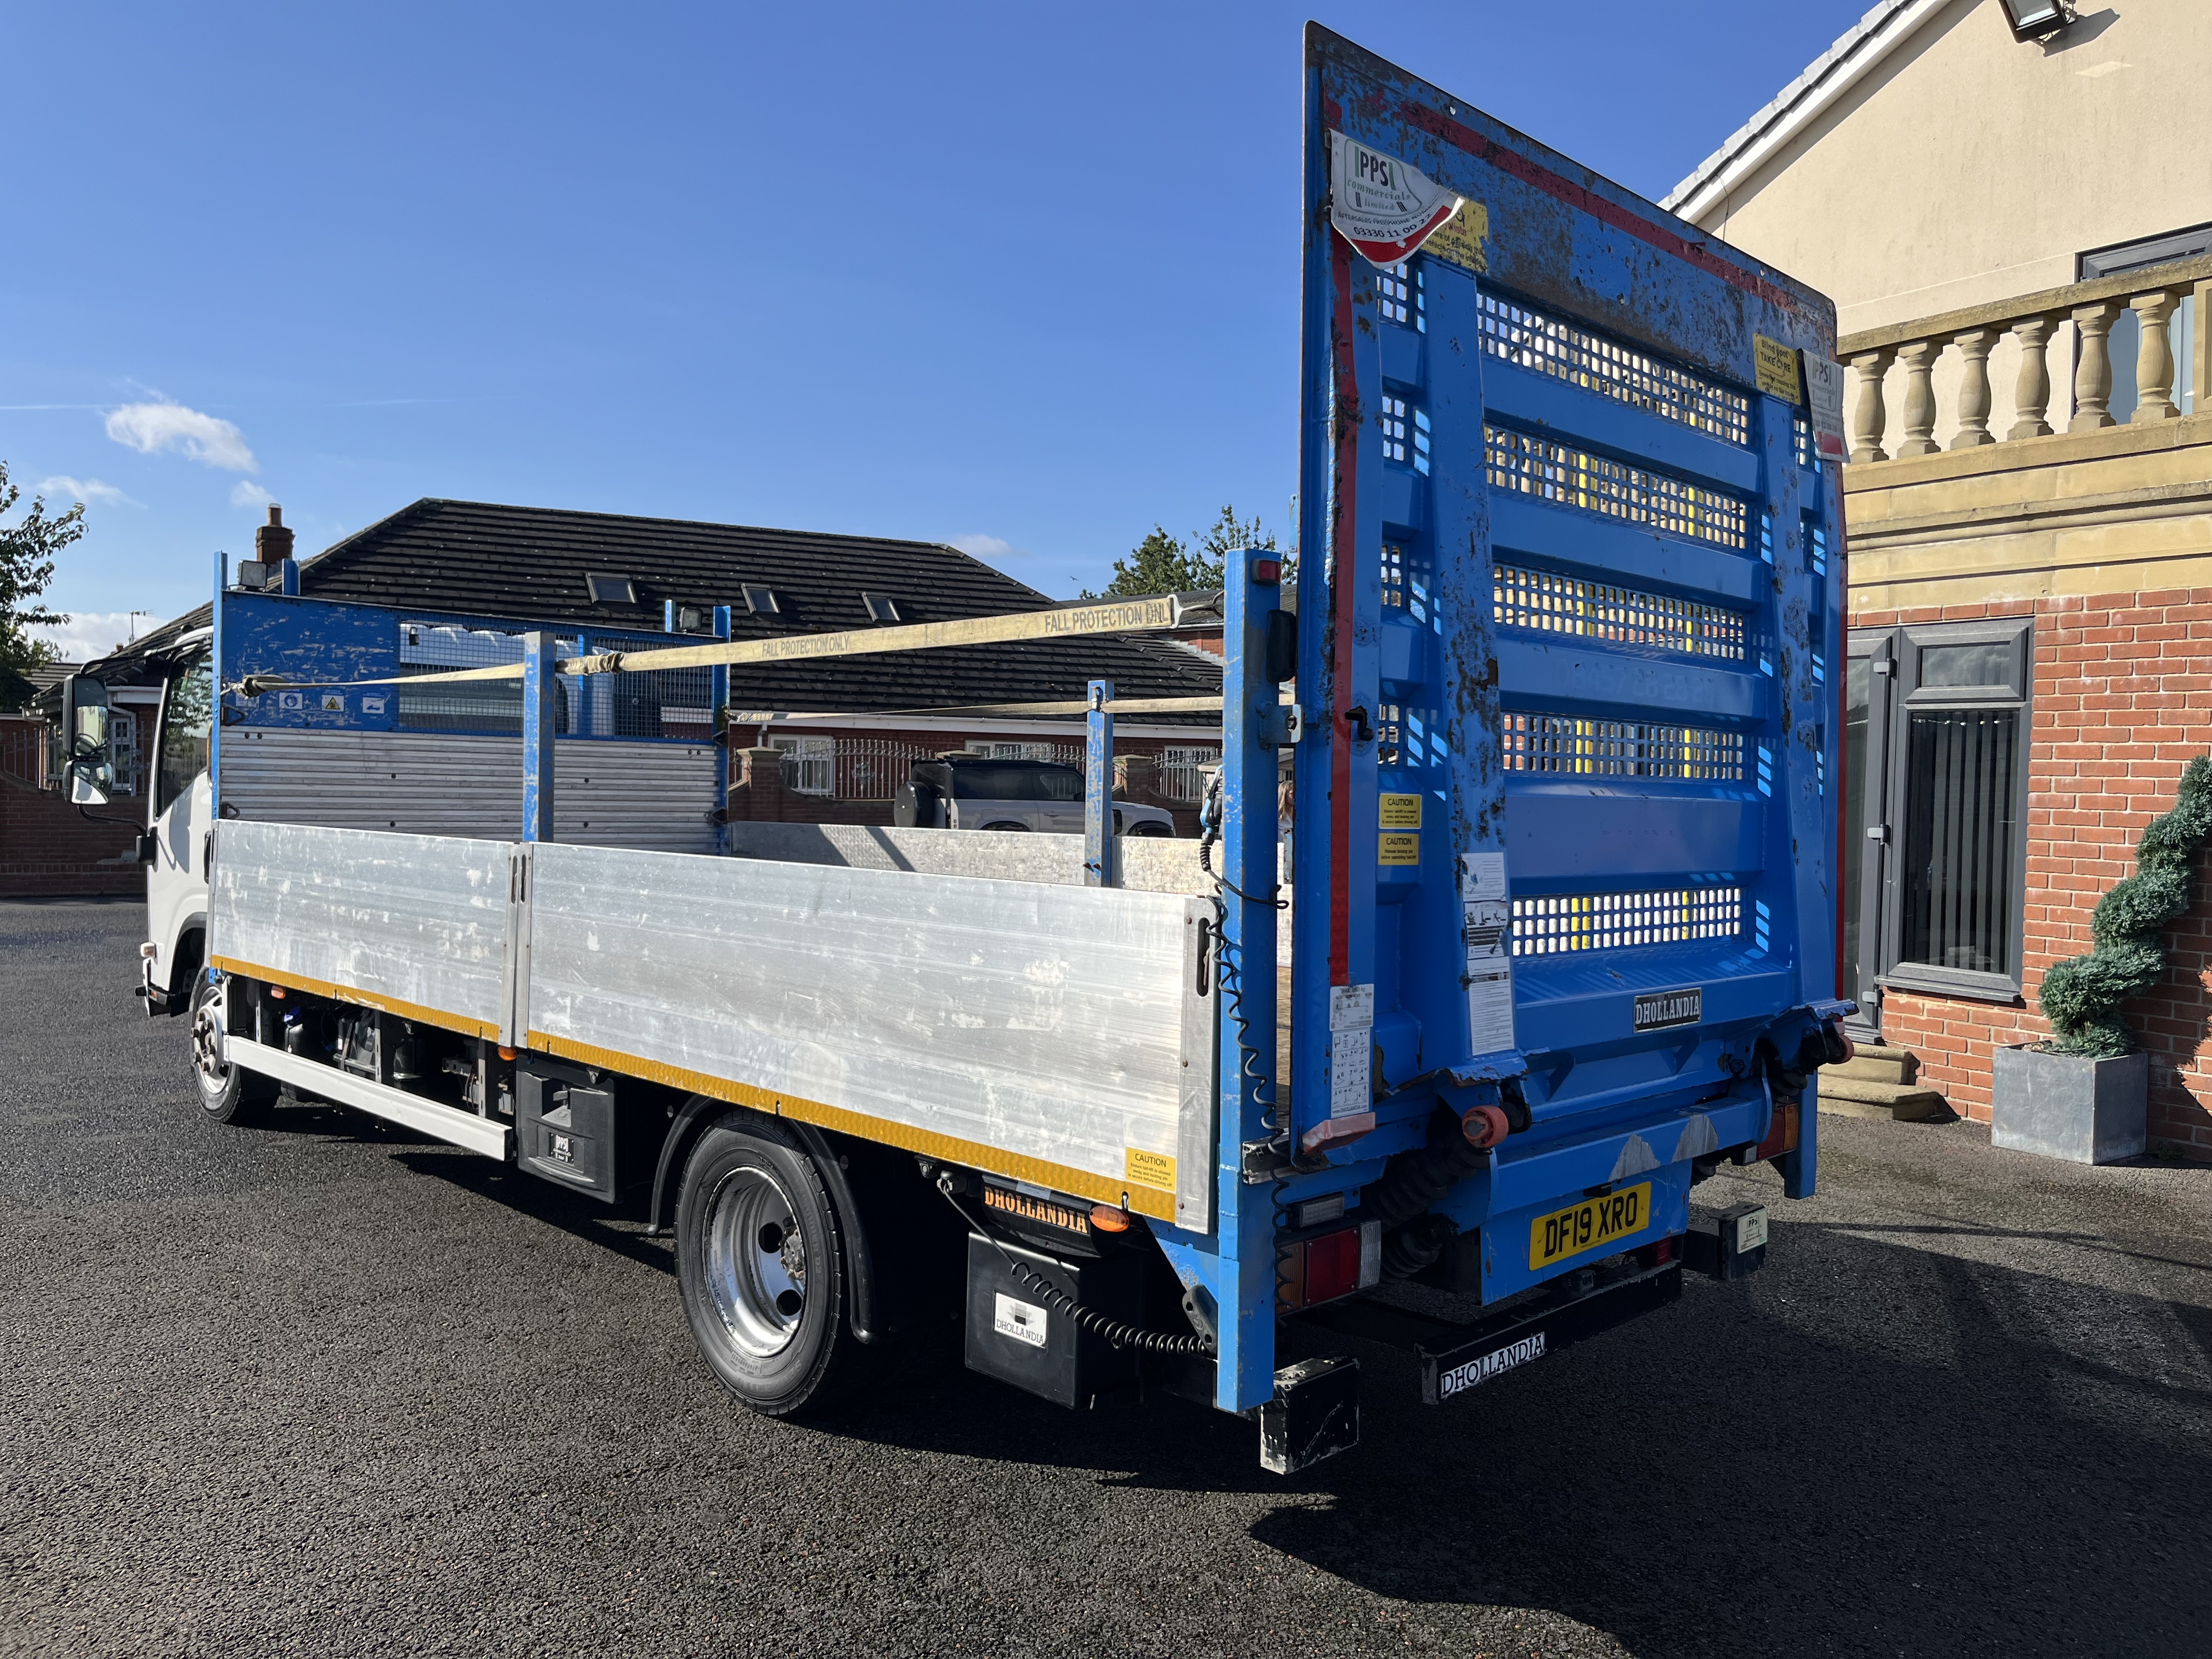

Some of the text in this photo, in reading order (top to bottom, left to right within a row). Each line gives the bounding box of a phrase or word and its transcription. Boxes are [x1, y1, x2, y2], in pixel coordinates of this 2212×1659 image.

[1361, 151, 1388, 186] PPS
[1347, 179, 1411, 201] commercials
[1364, 198, 1395, 211] limited
[1353, 226, 1385, 238] 03330
[1403, 224, 1417, 234] 00
[1418, 213, 1432, 225] 22
[1762, 339, 1775, 355] Blind
[1760, 351, 1791, 373] TAKE CARE
[1045, 613, 1070, 632] FALL
[1072, 605, 1142, 630] PROTECTION
[762, 635, 850, 657] FALL PROTECTION ONLY
[1387, 798, 1413, 806] CAUTION
[1635, 996, 1700, 1025] DHOLLANDIA
[1135, 1153, 1166, 1167] CAUTION
[984, 1186, 1088, 1234] DHOLLANDIA
[1544, 1192, 1638, 1258] DF19 XRO
[996, 1318, 1043, 1344] DHOLLANDIA
[1442, 1335, 1543, 1395] DHOLLANDIA
